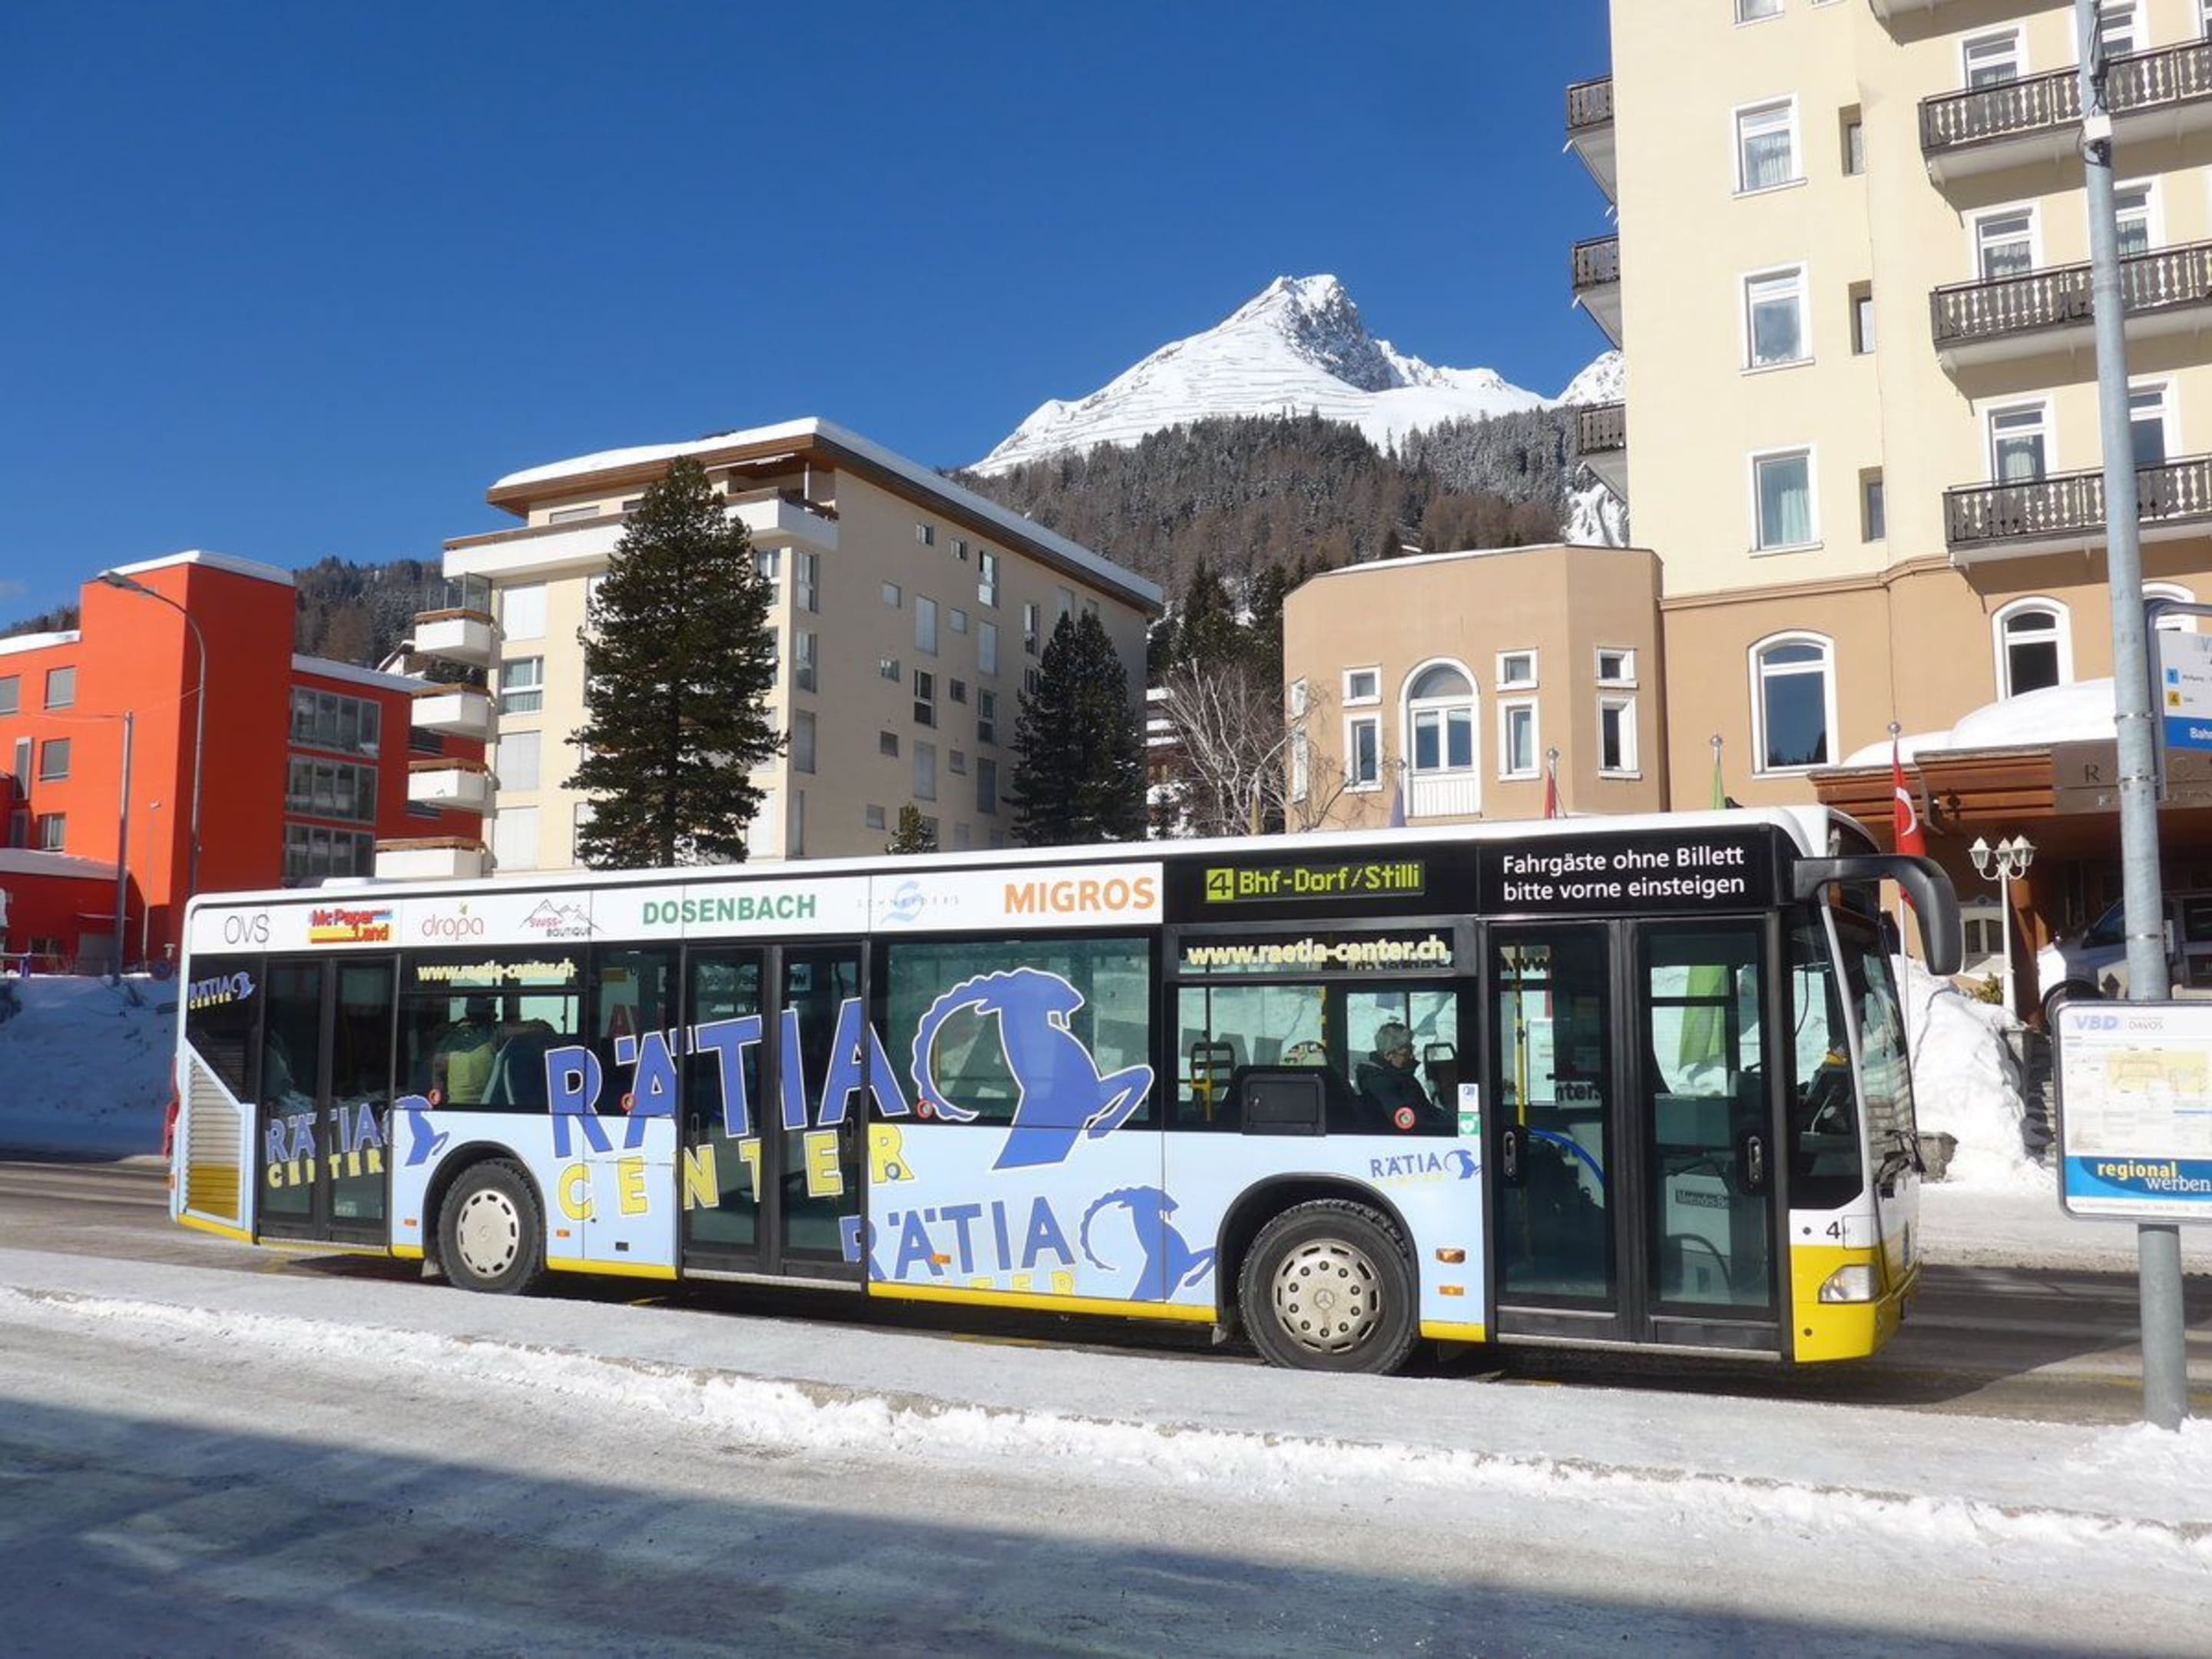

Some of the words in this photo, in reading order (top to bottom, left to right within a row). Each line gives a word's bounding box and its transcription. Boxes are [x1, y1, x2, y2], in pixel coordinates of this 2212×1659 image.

[1503, 853, 1606, 877] Fahrgäste
[1614, 849, 1669, 869] ohne
[1677, 846, 1744, 866] Billett
[1208, 873, 1232, 896] 4
[1240, 864, 1419, 894] Bhf-Dorf/Stilli
[1504, 882, 1553, 901] bitte
[1560, 882, 1621, 899] vorne
[1628, 875, 1745, 899] einsteigen
[643, 894, 816, 924] DOSENBACH
[1004, 877, 1154, 914] MIGROS
[224, 914, 269, 944] OVS
[422, 914, 484, 940] dropa
[2075, 1015, 2118, 1030] VBD
[544, 997, 908, 1158] RÄTIA
[558, 1123, 915, 1221] CENTER
[1370, 1152, 1442, 1178] RÄTIA
[2098, 1160, 2177, 1180] regional
[2144, 1175, 2211, 1191] werben
[839, 1196, 1075, 1281] RÄTIA
[1826, 1221, 1841, 1240] 4
